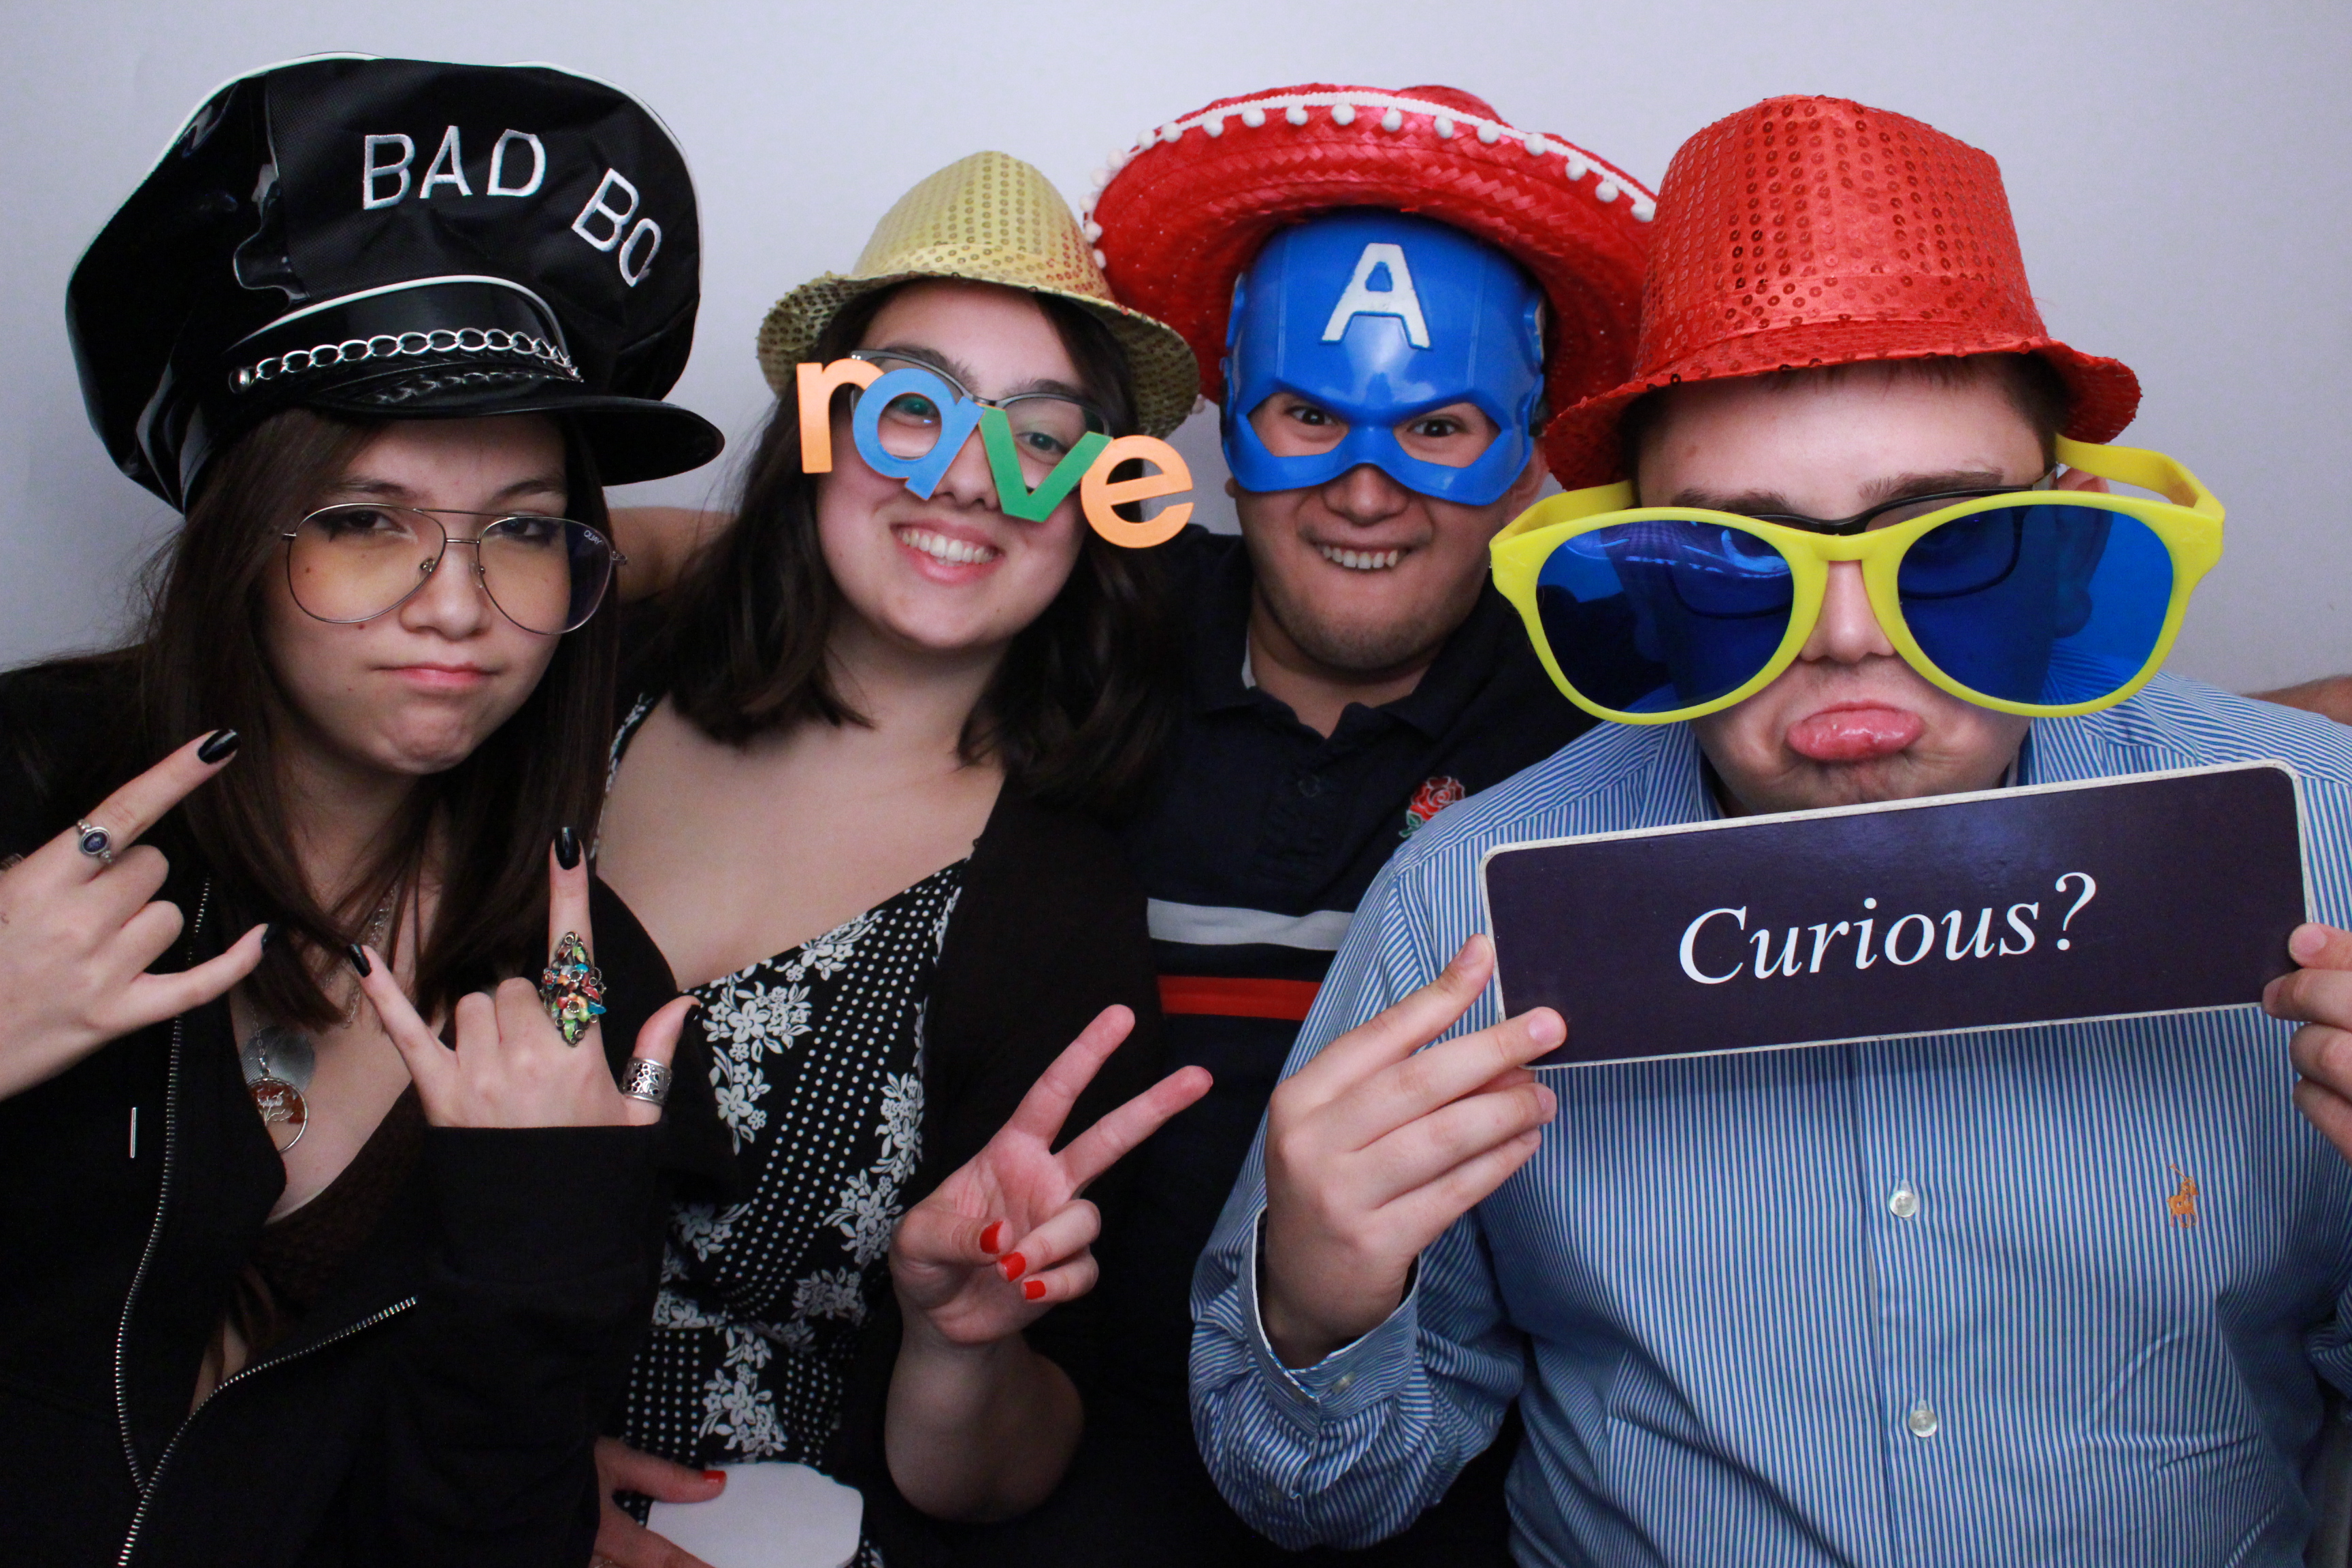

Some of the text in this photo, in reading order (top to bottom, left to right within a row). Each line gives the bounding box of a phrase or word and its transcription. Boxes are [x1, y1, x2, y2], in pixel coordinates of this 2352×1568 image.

[363, 125, 545, 210] BAD
[1321, 242, 1431, 349] A
[796, 357, 1194, 548] rave
[584, 530, 602, 544] QUAY
[1679, 872, 2096, 984] Curious?
